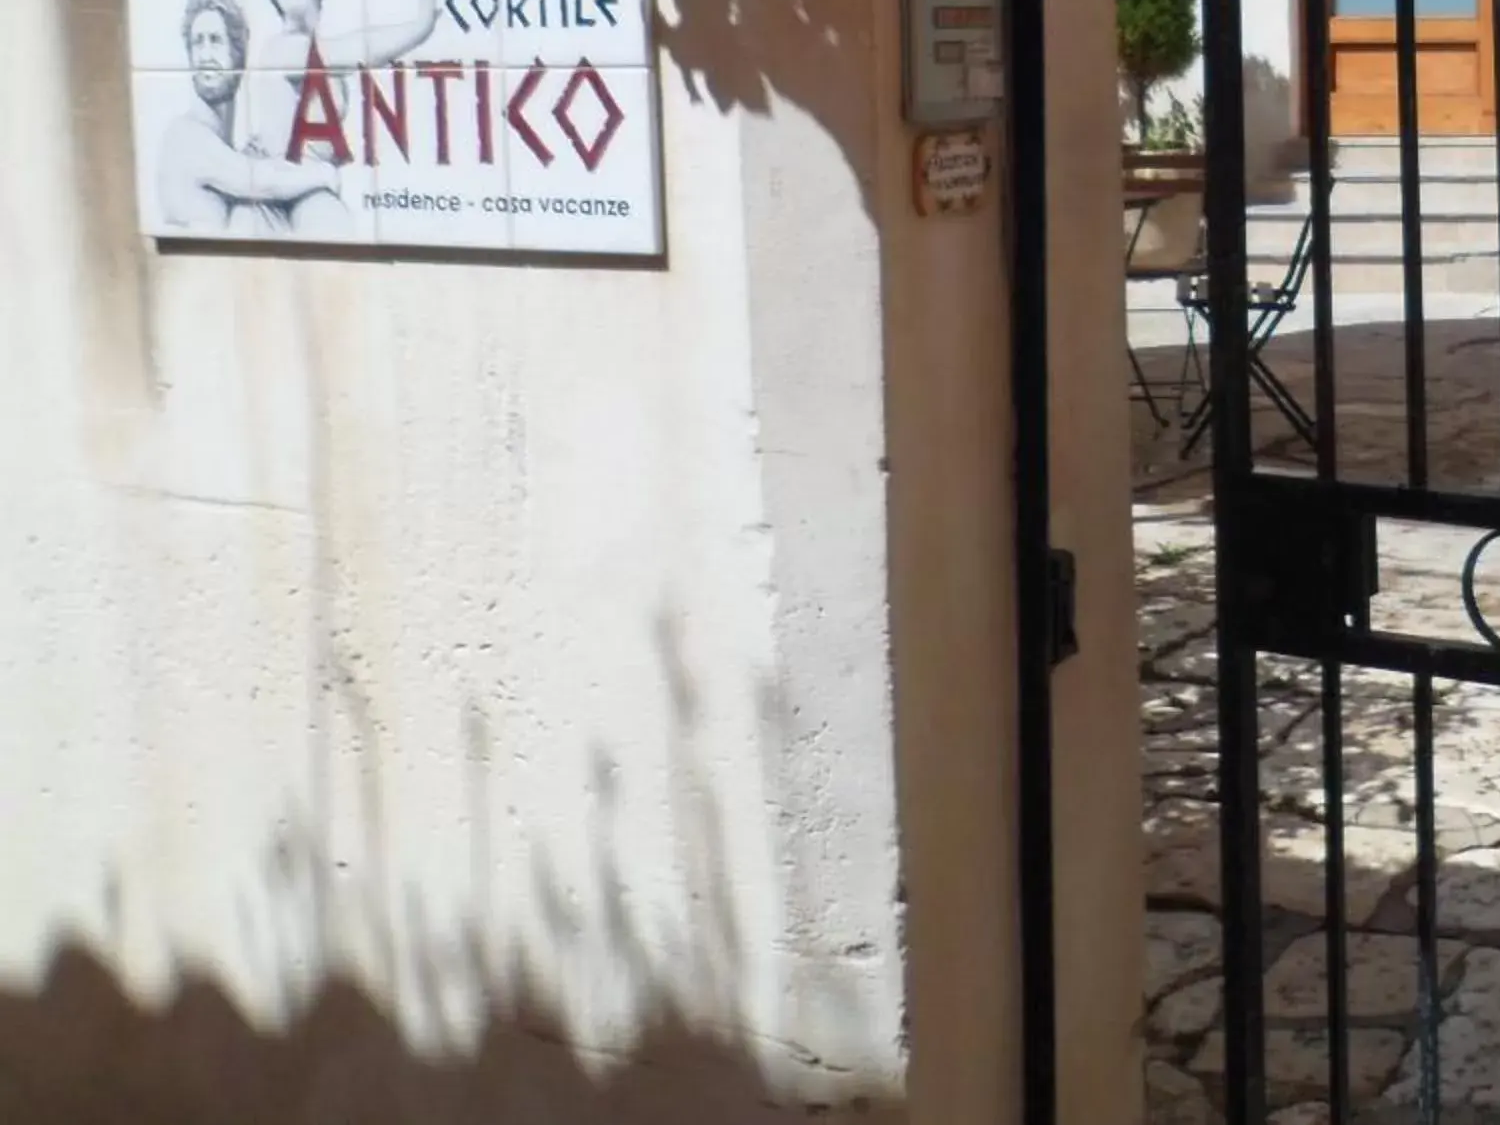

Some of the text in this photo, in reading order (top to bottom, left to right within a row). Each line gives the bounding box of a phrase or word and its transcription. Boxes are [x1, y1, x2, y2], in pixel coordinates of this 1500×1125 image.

[286, 36, 625, 172] ANTICO
[363, 188, 460, 212] residence
[483, 196, 531, 213] casa
[538, 197, 630, 218] vacanze
